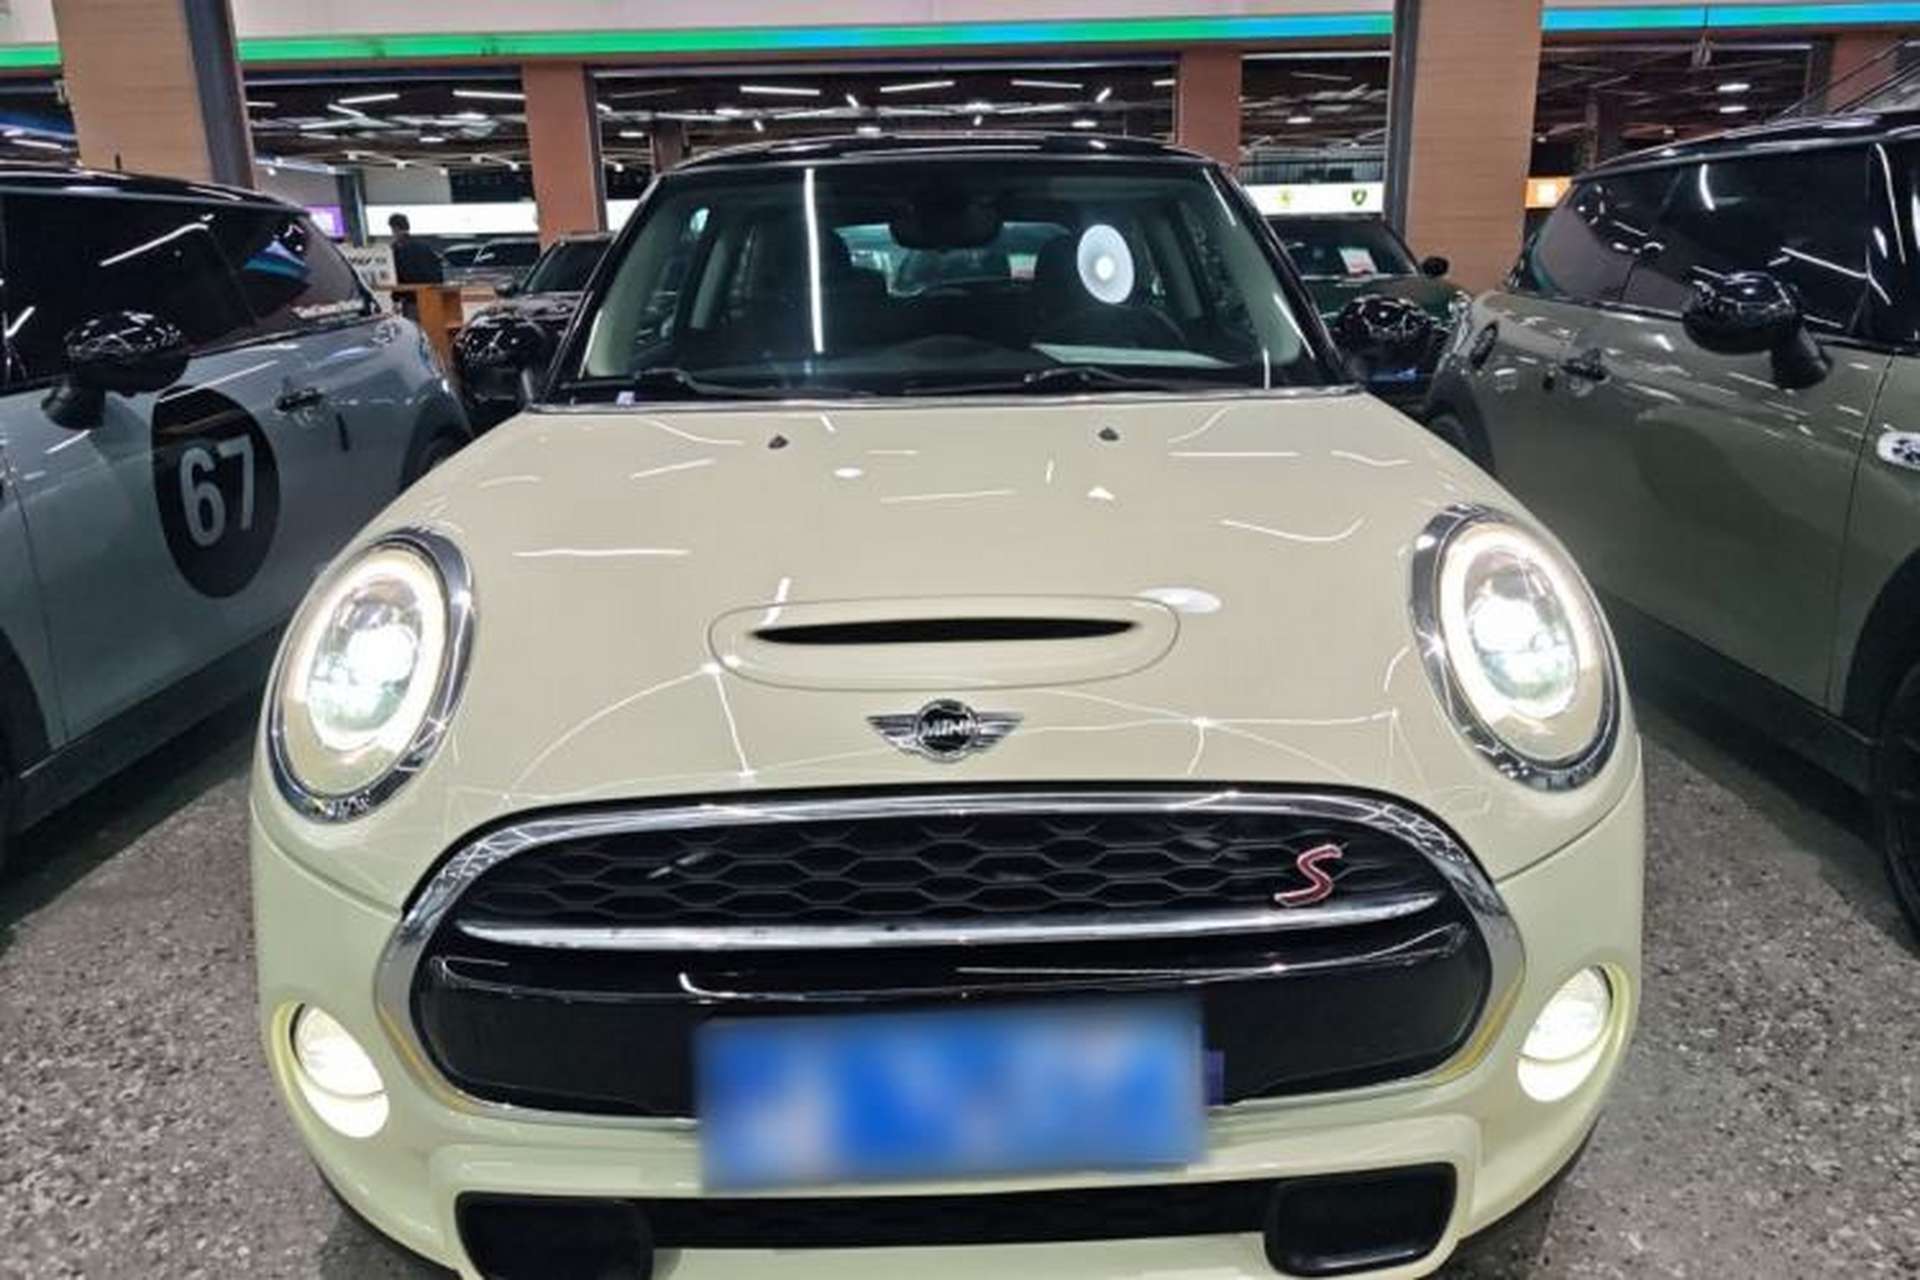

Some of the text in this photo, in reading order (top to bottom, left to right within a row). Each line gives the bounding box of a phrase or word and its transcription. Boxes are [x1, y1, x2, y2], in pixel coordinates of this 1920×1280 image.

[180, 434, 255, 547] 67
[921, 717, 979, 737] MINI
[1273, 843, 1342, 908] S
